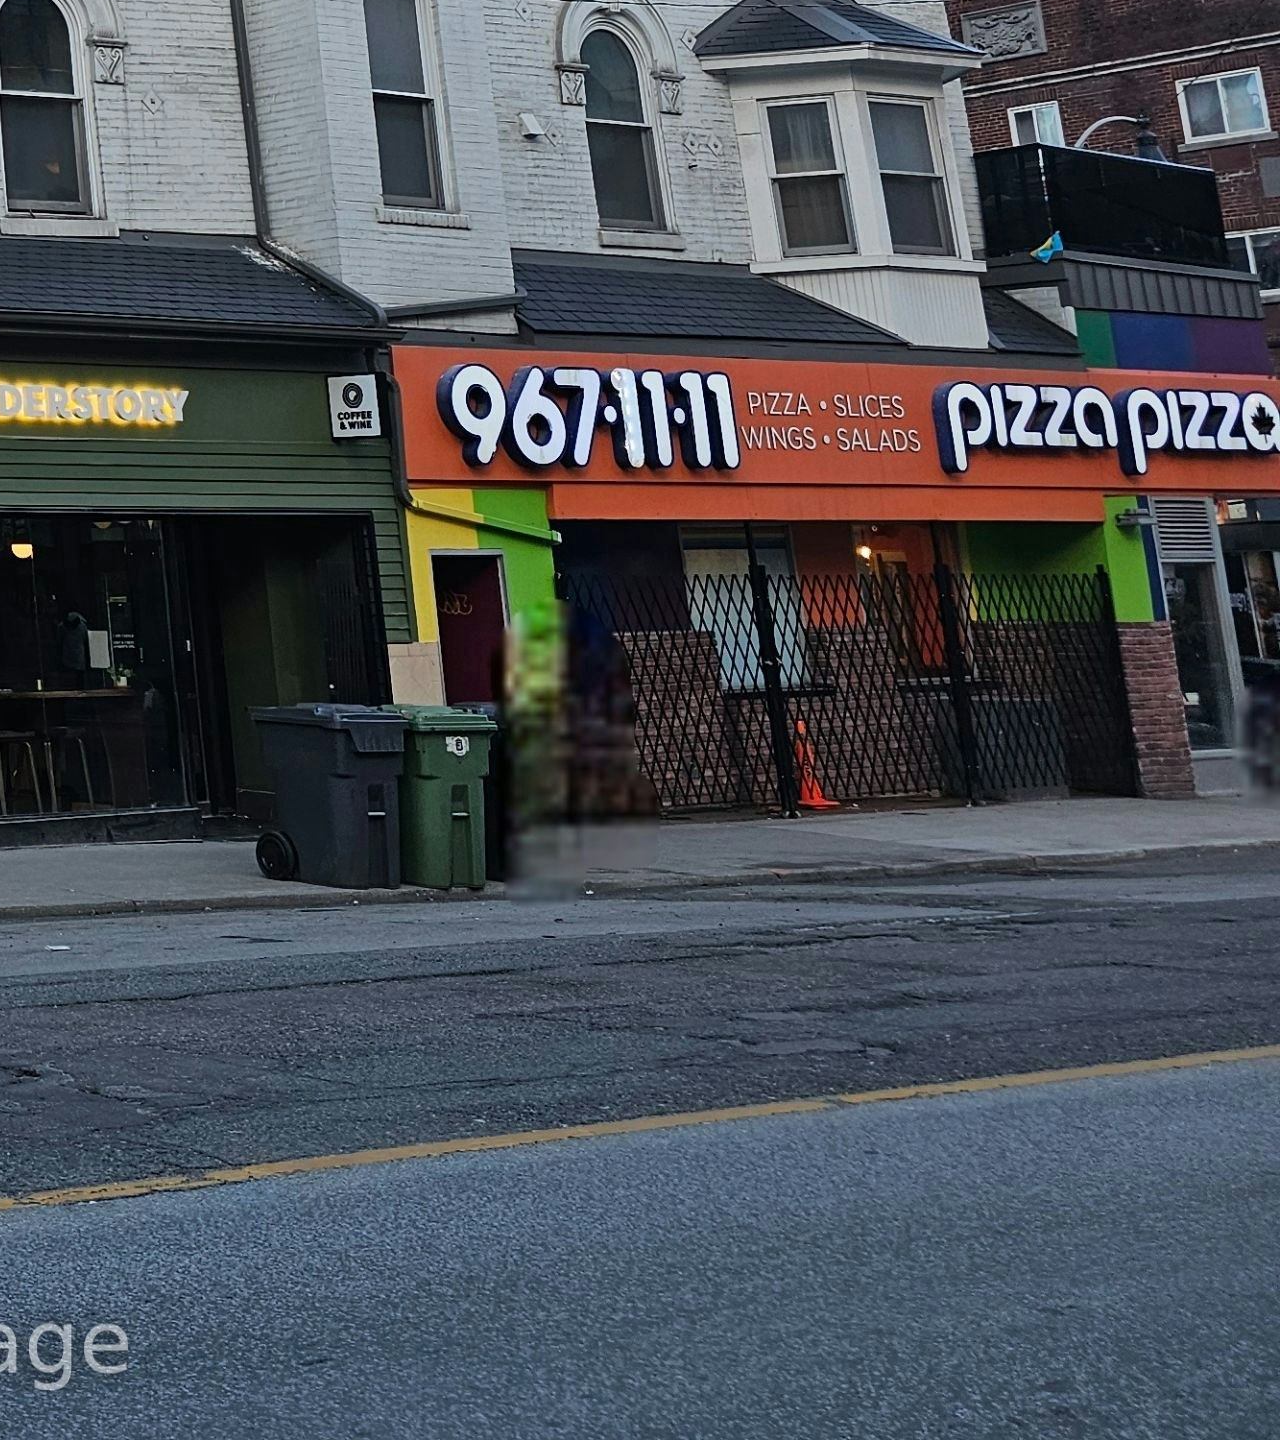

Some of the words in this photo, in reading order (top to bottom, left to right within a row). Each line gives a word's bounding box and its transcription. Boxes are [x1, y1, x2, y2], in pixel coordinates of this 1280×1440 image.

[748, 392, 811, 417] PIZZA
[833, 395, 905, 419] SLICES
[337, 411, 373, 421] COFFEE
[340, 421, 347, 430] &
[348, 420, 373, 430] WINE
[742, 426, 816, 451] WINGS
[838, 429, 921, 453] SALADS
